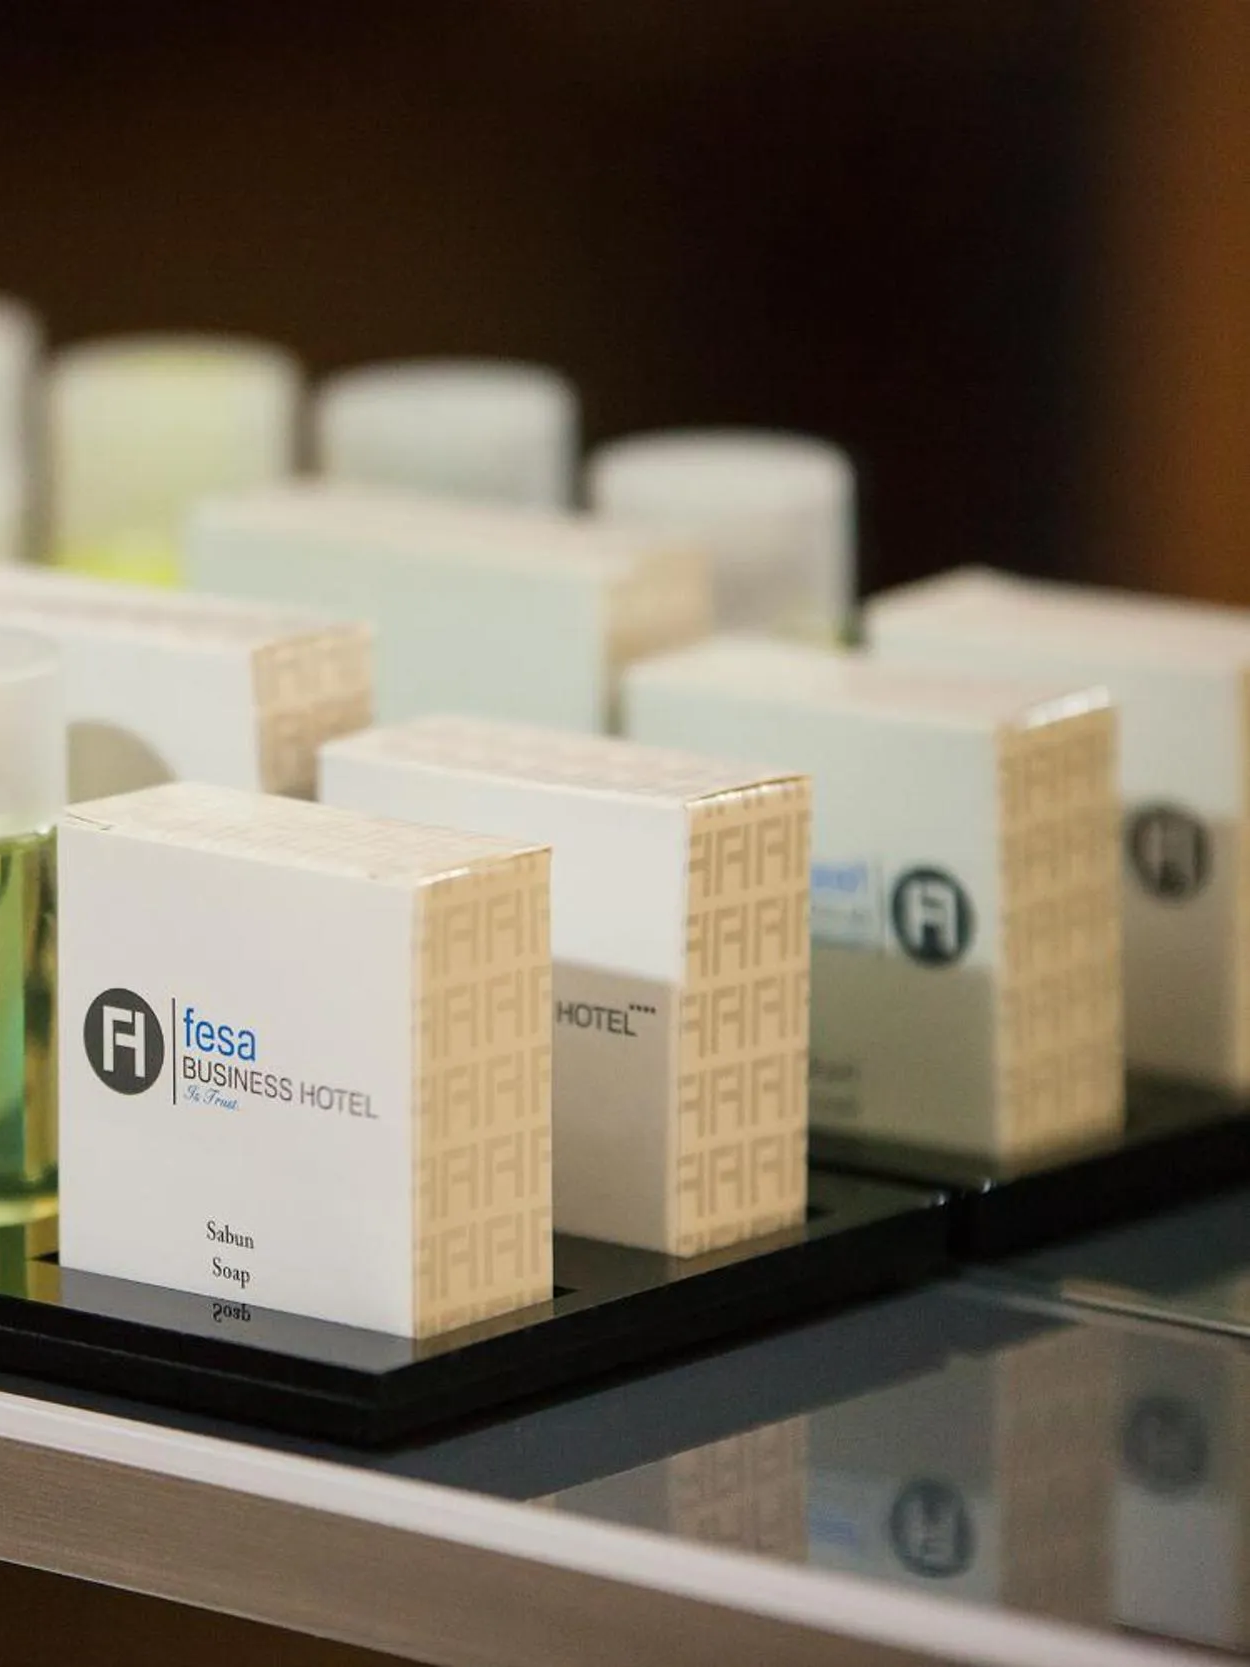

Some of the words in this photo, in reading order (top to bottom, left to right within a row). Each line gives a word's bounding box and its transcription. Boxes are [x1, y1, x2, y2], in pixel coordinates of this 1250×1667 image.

[183, 1007, 256, 1062] fesa
[182, 1056, 293, 1102] BUSINESS
[300, 1081, 379, 1120] HOTEL
[206, 1220, 254, 1249] Sabun
[212, 1256, 251, 1289] Soap
